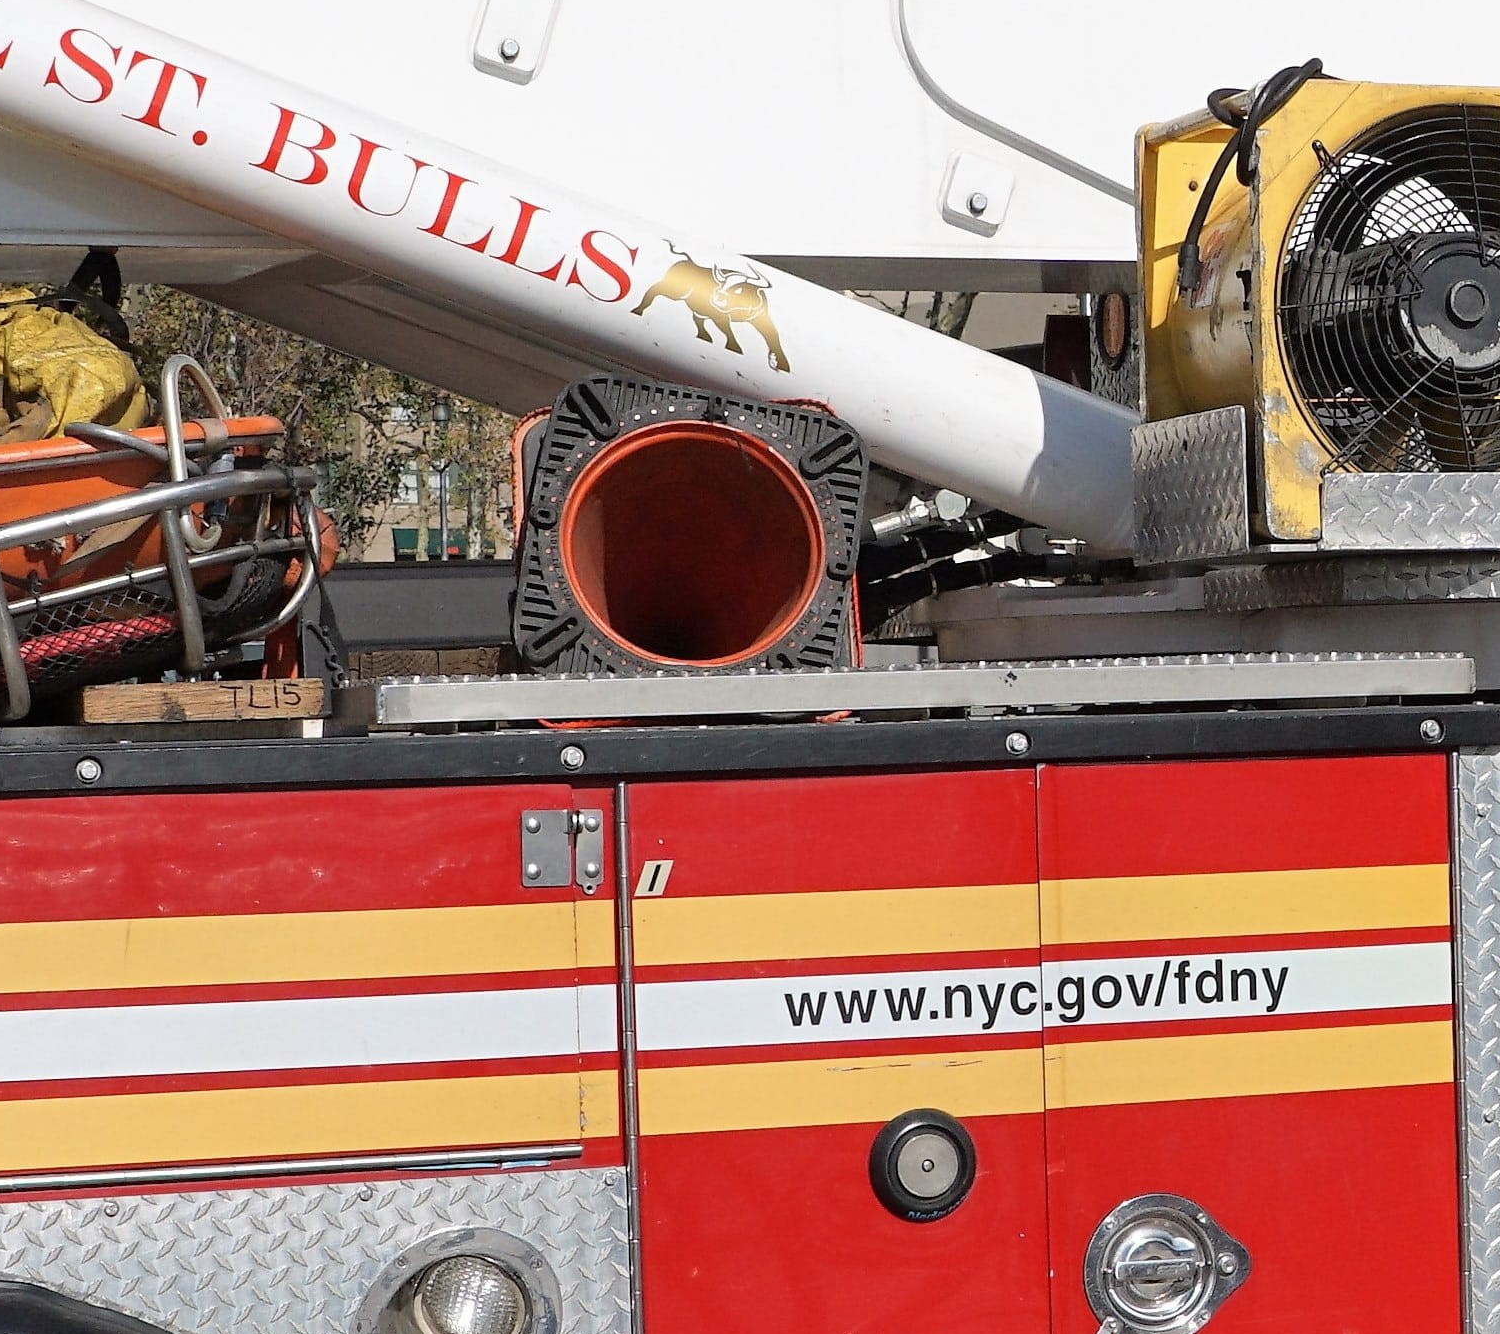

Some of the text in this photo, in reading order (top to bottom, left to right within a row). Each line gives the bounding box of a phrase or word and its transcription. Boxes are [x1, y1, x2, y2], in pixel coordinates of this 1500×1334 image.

[44, 27, 210, 146] ST.
[251, 101, 643, 304] BULLS
[219, 680, 302, 709] TL15
[784, 958, 1289, 1029] www.nyc.gov/fdny
